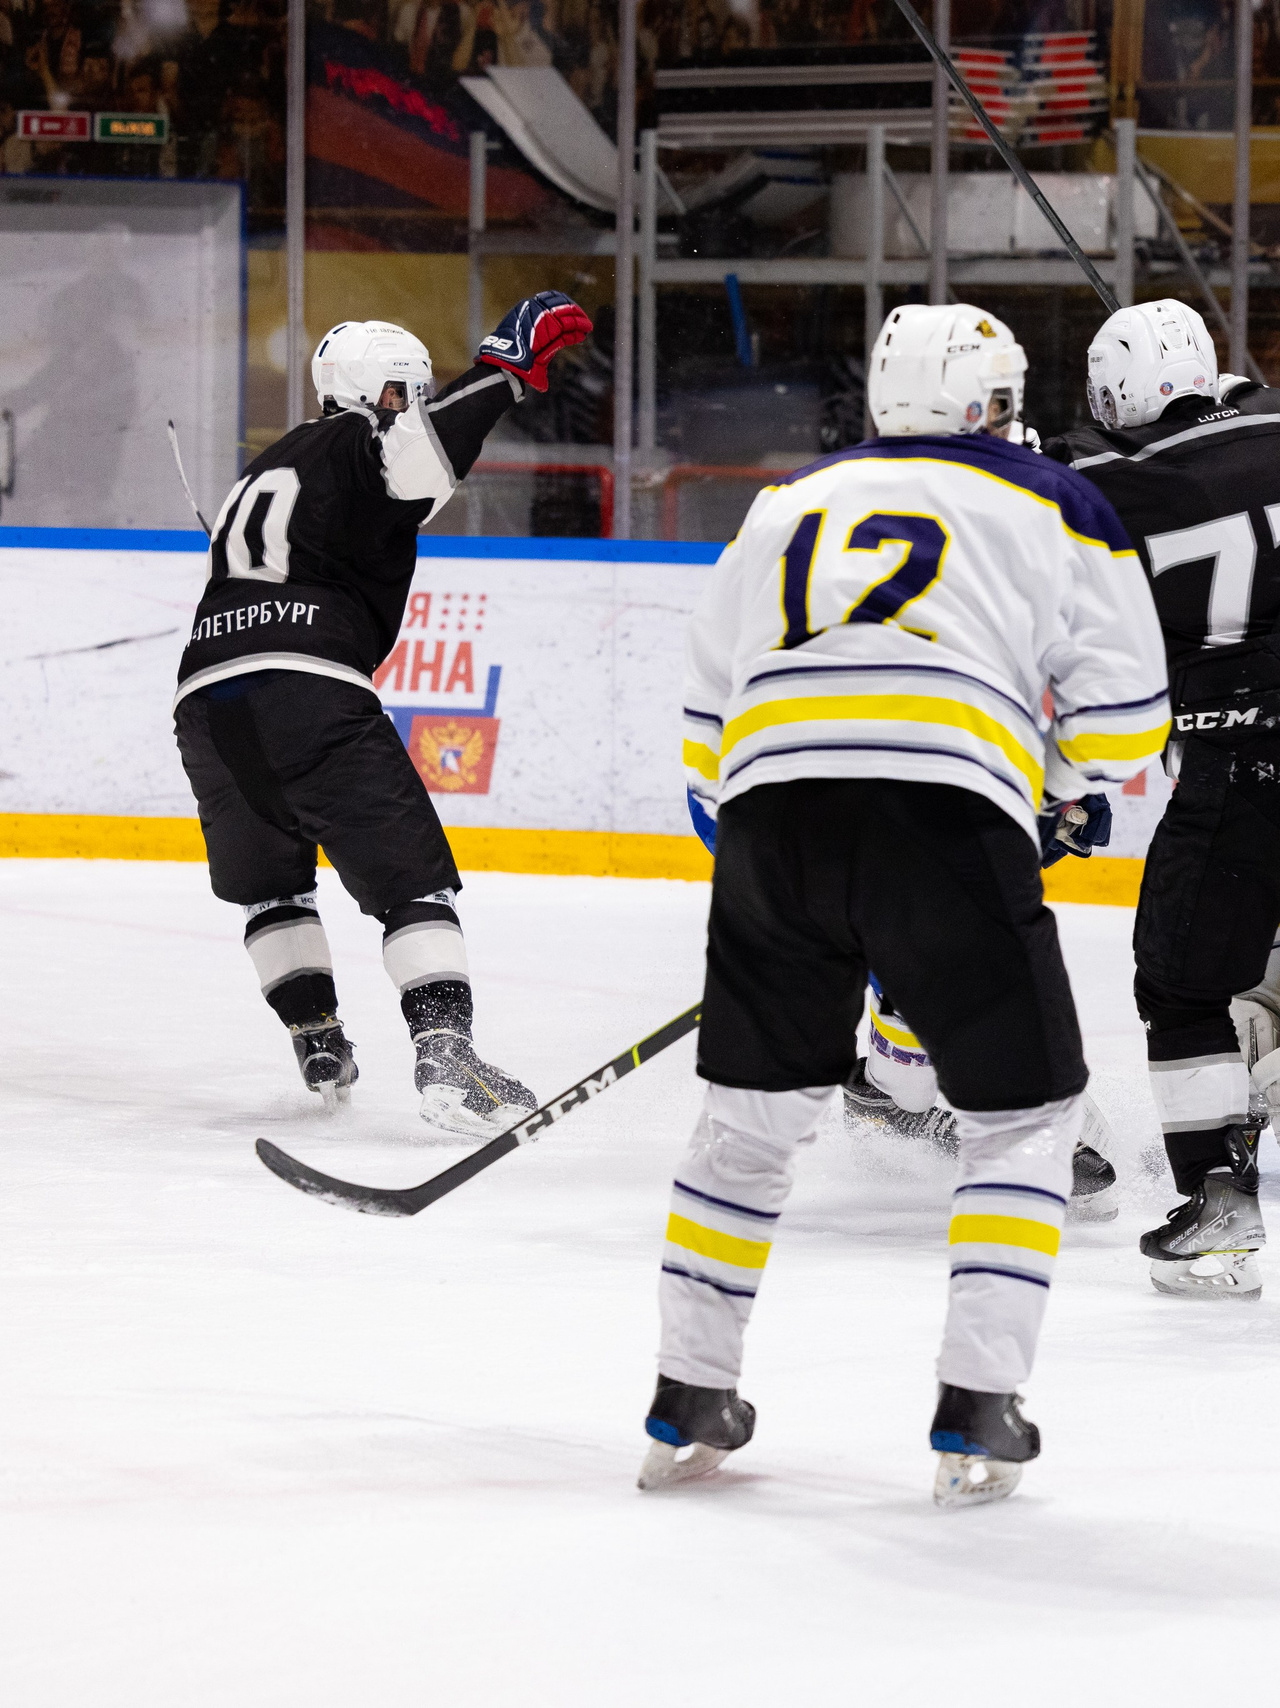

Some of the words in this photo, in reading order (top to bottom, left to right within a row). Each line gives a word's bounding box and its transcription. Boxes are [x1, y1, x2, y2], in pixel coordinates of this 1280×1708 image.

[948, 344, 981, 353] CCM
[1197, 408, 1240, 424] LUTCH
[769, 507, 952, 651] 12
[1173, 707, 1260, 733] CCM
[511, 1065, 618, 1146] CCM
[1169, 1222, 1199, 1250] BAUER
[1181, 1209, 1244, 1254] VAPOR
